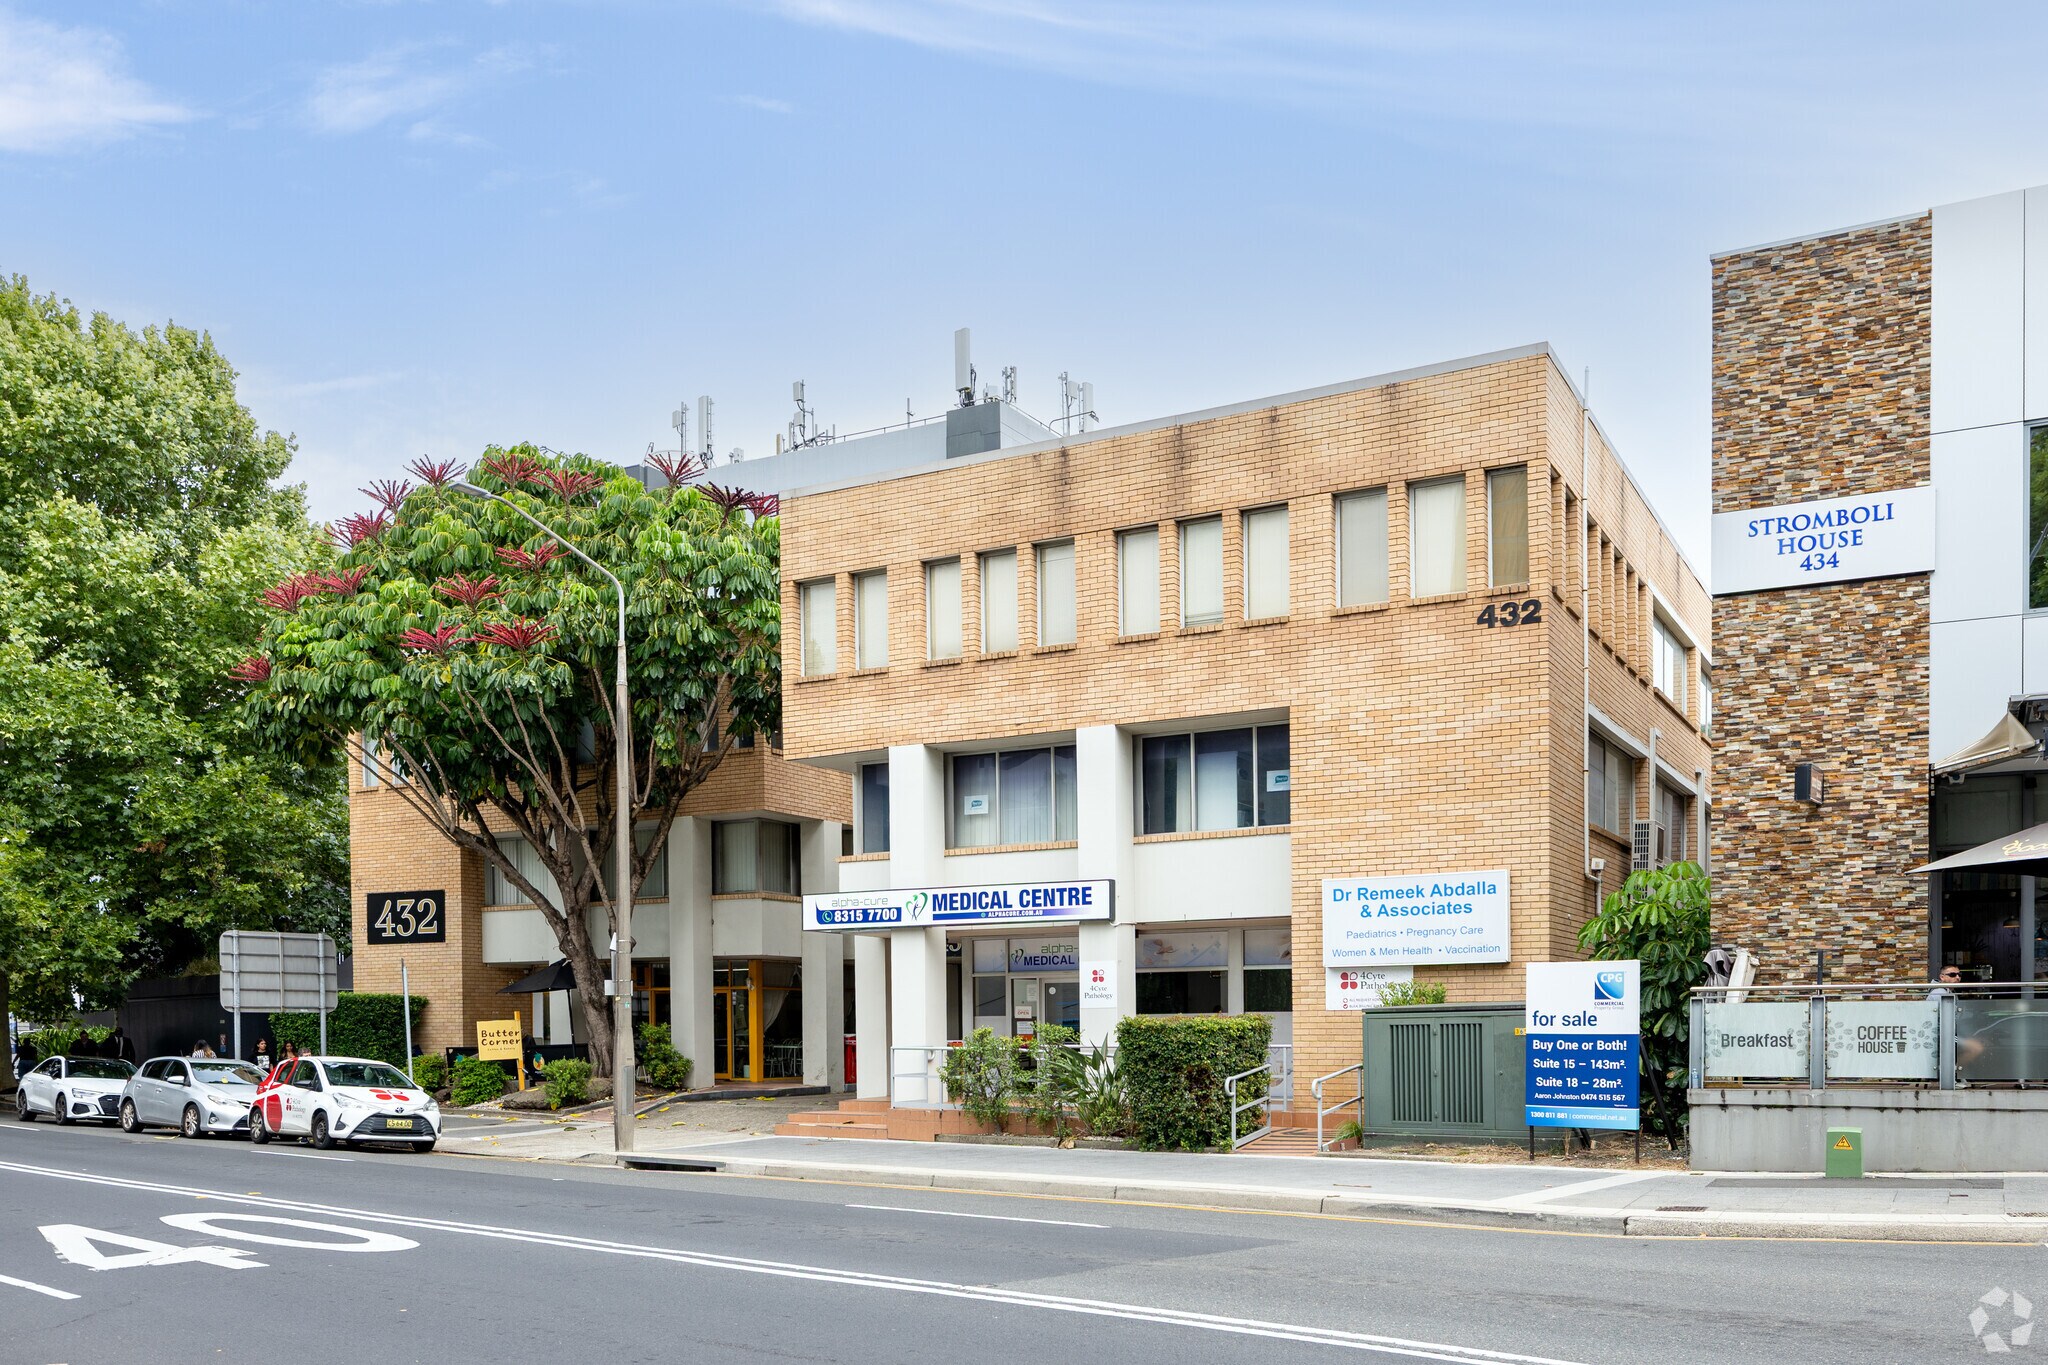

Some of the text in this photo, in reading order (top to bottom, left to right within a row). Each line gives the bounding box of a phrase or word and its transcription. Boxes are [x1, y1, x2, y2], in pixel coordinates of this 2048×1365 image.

[1748, 503, 1894, 537] STROMBOLI
[1777, 529, 1863, 555] HOUSE
[1800, 552, 1839, 571] 434
[1476, 599, 1542, 628] 432
[1333, 881, 1497, 902] Dr Remeek Abdalla
[831, 896, 889, 908] alpha-cure
[932, 887, 1093, 912] MEDICAL CENTRE
[834, 908, 897, 922] 8315 7700
[987, 909, 1043, 918] ALPHACURE.COM.AU
[1360, 902, 1473, 918] & Associates
[374, 898, 438, 937] 432
[1346, 925, 1484, 939] Paediatrics Pregnancy Care
[1041, 943, 1079, 955] alpha-
[1332, 943, 1501, 958] Women & Men Health Vaccination
[1023, 955, 1075, 966] MEDICAL
[1360, 971, 1386, 981] 4Cyte
[1600, 973, 1623, 983] CPG
[1532, 1010, 1598, 1026] for sale
[481, 1029, 520, 1038] Butter
[1857, 1026, 1907, 1040] COFFEE
[481, 1038, 521, 1046] Corner
[1532, 1040, 1627, 1052] Buy One or Both!
[1721, 1033, 1793, 1048] Breakfast
[1858, 1041, 1894, 1053] HOUSE
[1533, 1058, 1560, 1068] Suite
[1563, 1059, 1575, 1069] 15
[1536, 1077, 1563, 1087] Suite
[1566, 1078, 1578, 1087] 18
[1581, 1093, 1597, 1101] 0474
[1572, 1113, 1627, 1121] commercial.net.au
[37, 1212, 420, 1271] 40
